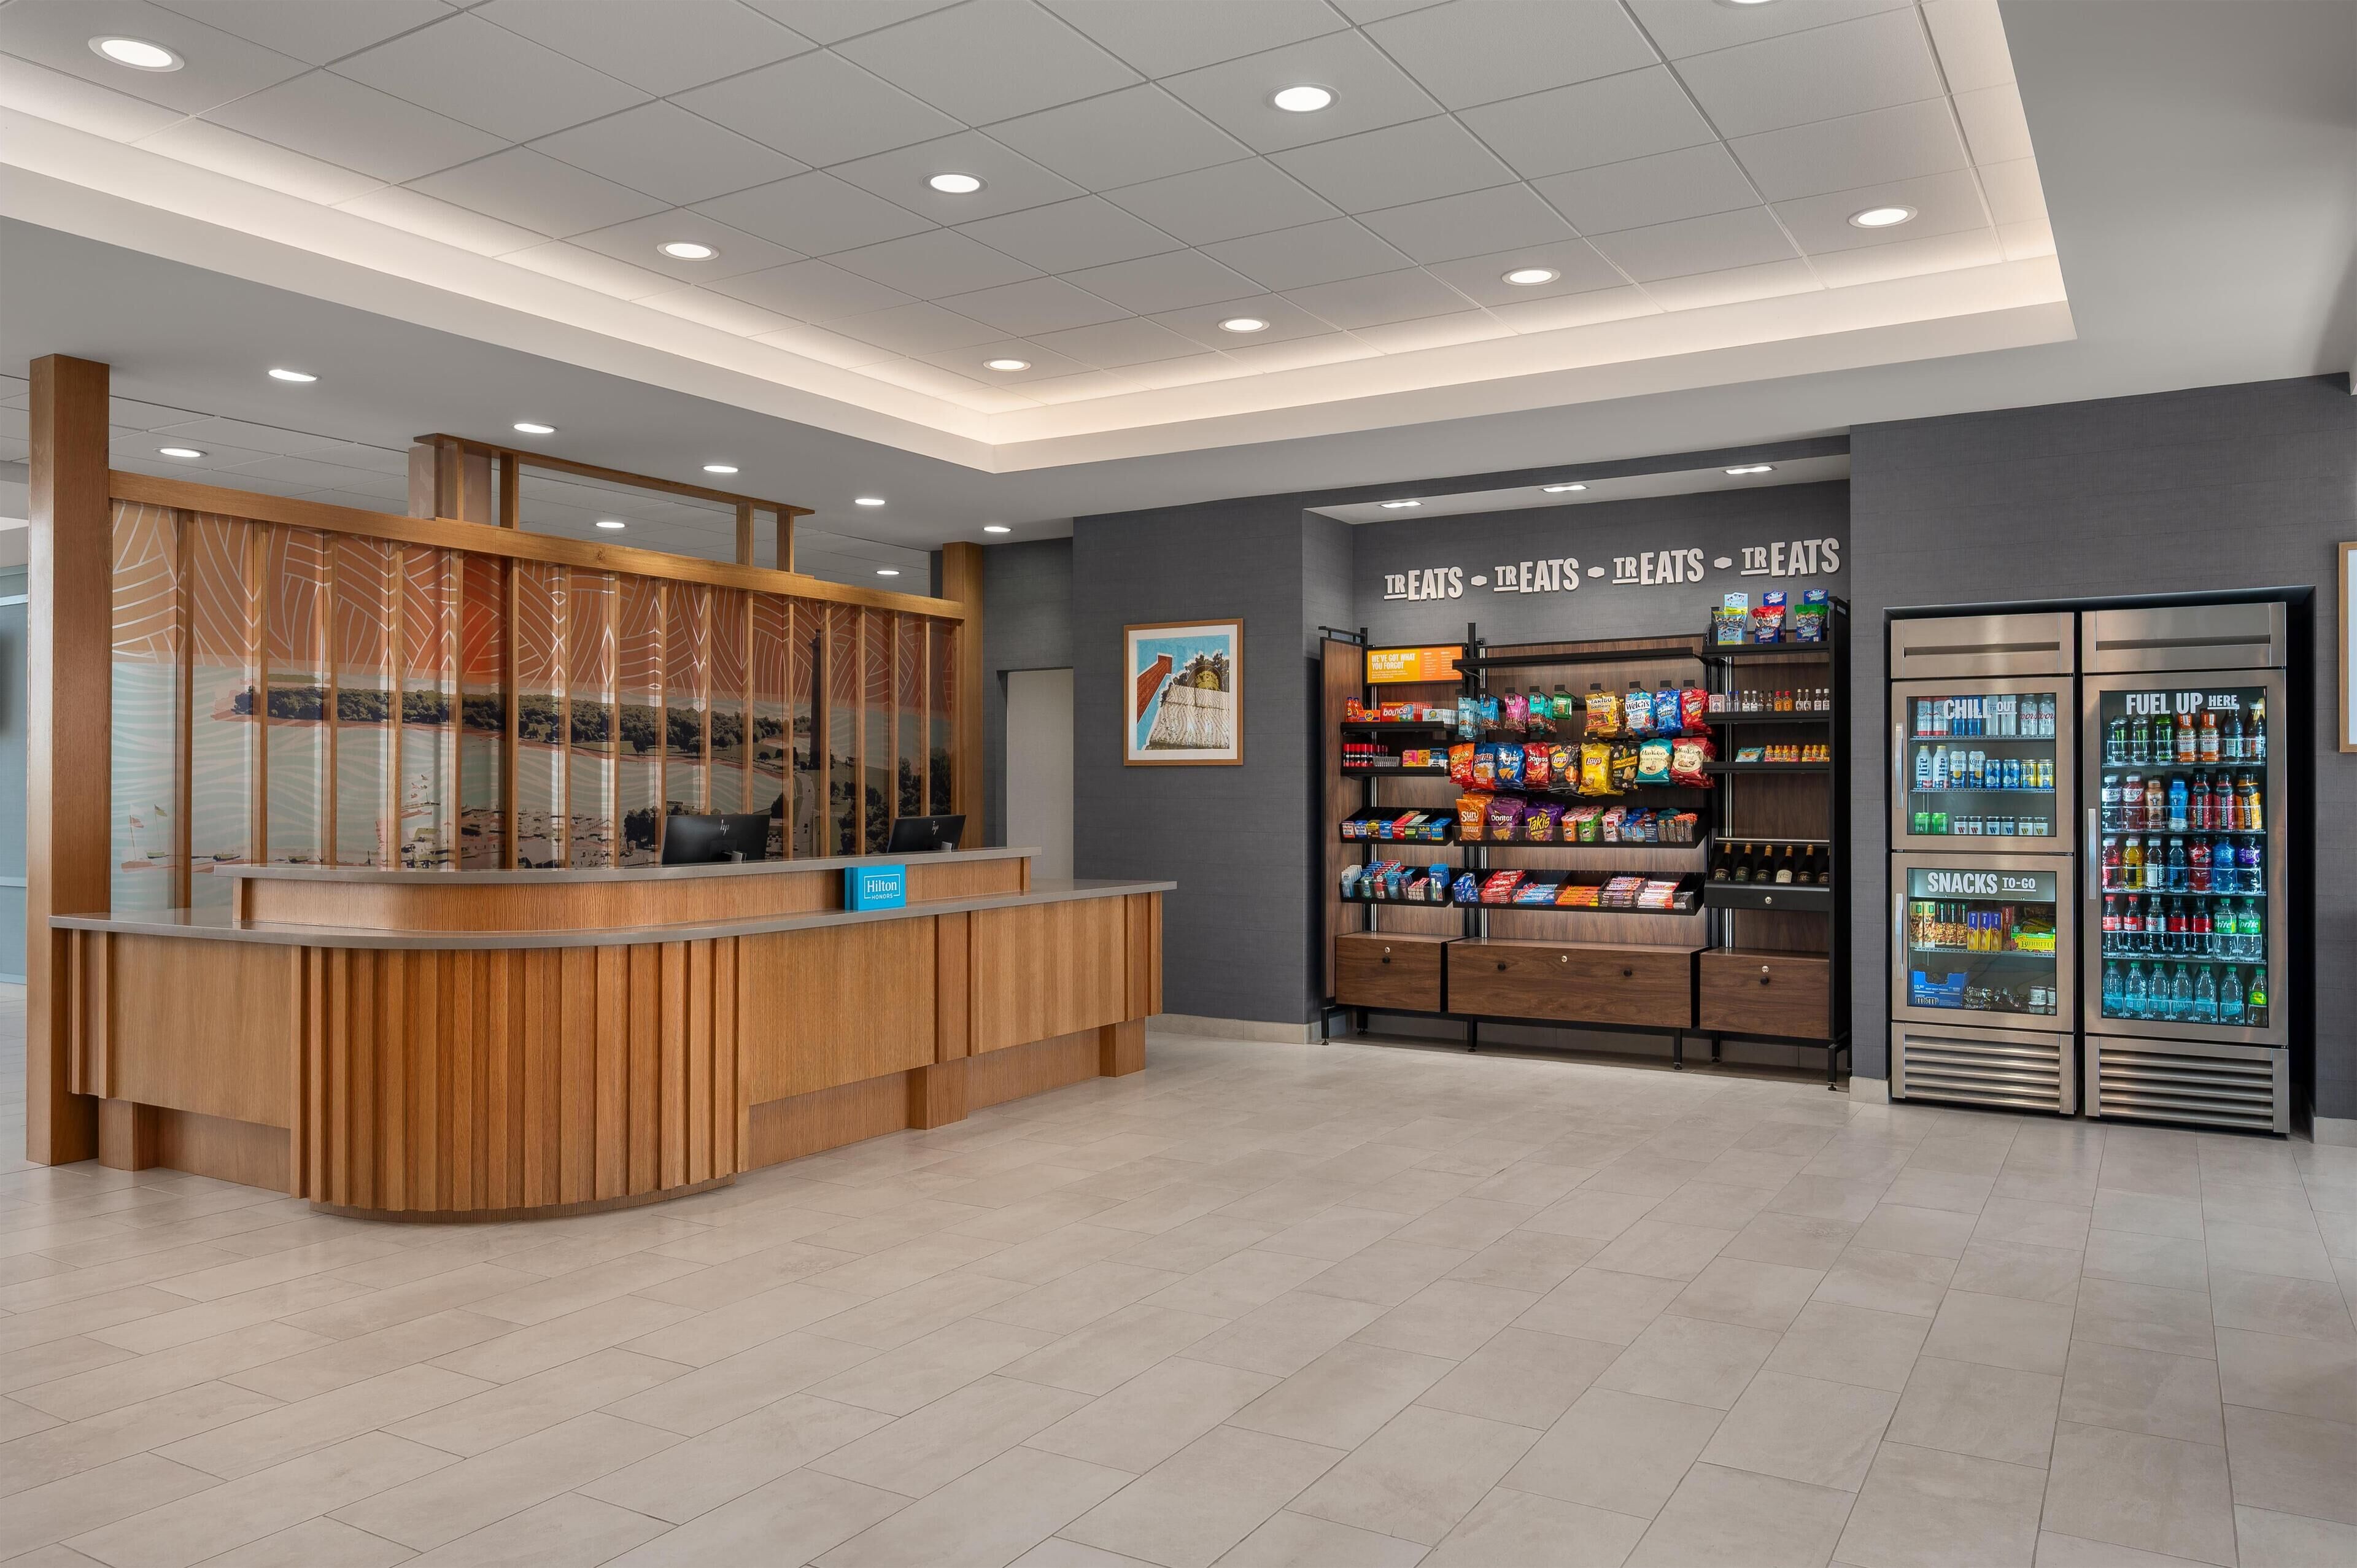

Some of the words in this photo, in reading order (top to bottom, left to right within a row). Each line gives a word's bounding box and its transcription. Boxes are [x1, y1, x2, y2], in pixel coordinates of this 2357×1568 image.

[1384, 566, 1463, 601] TREATS
[1493, 558, 1579, 593] TREATS
[1612, 547, 1705, 585] TREATS
[1741, 538, 1840, 576] TREATS
[1943, 698, 1992, 720] CHILL
[1997, 700, 2017, 712] OUT
[2126, 693, 2170, 715] FUEL
[2176, 692, 2203, 714] UP
[2208, 695, 2238, 707] HERE
[1383, 706, 1409, 717] bounce
[1586, 757, 1602, 765] Lay's
[1613, 758, 1636, 767] Smartfood
[1461, 811, 1479, 822] Sun
[1527, 816, 1550, 833] Takis
[867, 879, 897, 893] Hilton
[1927, 872, 1998, 894] SNACKS
[2002, 877, 2036, 889] TO-GO
